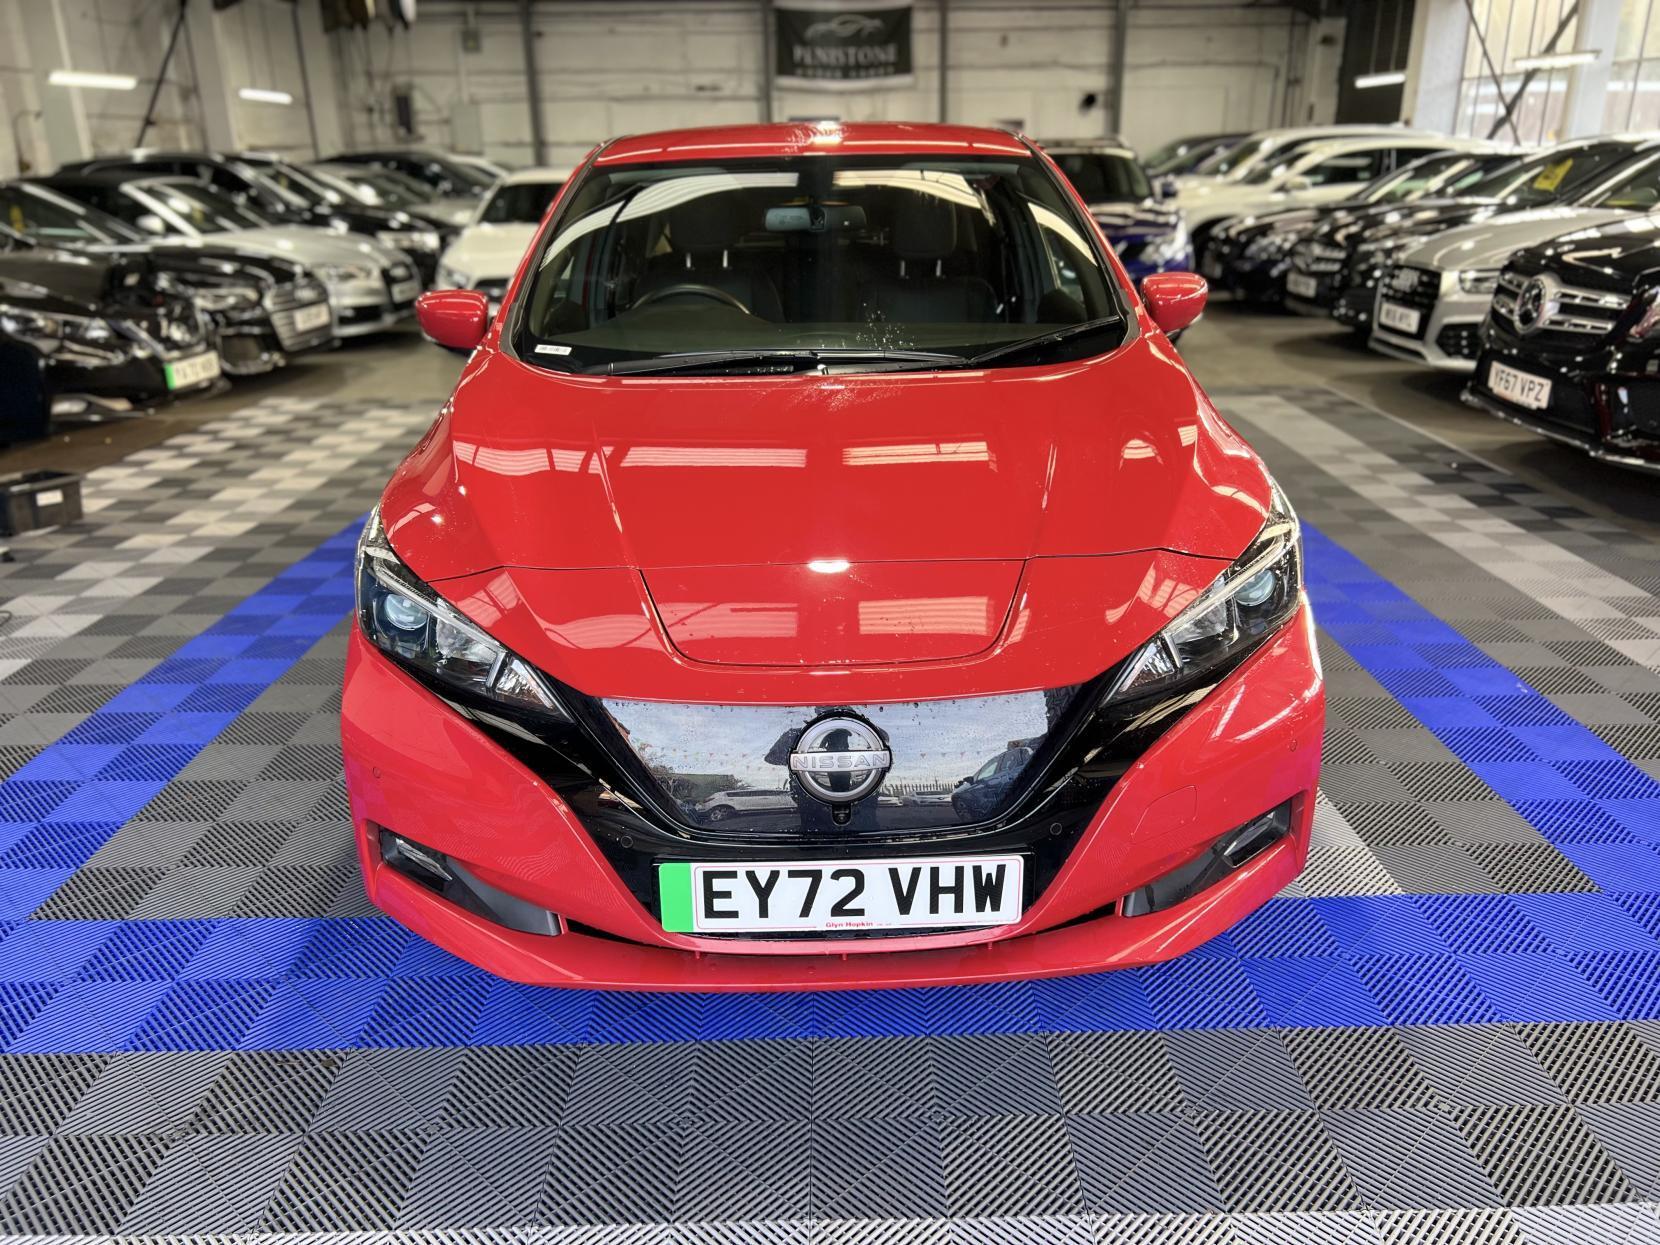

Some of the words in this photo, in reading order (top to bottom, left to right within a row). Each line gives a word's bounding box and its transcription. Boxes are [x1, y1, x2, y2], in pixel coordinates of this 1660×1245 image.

[793, 43, 897, 66] PENISTONE
[1494, 369, 1518, 393] YF67
[1520, 377, 1544, 402] VPZ
[792, 753, 888, 769] NISSAN
[702, 868, 866, 919] EY72
[888, 864, 1007, 916] VHW
